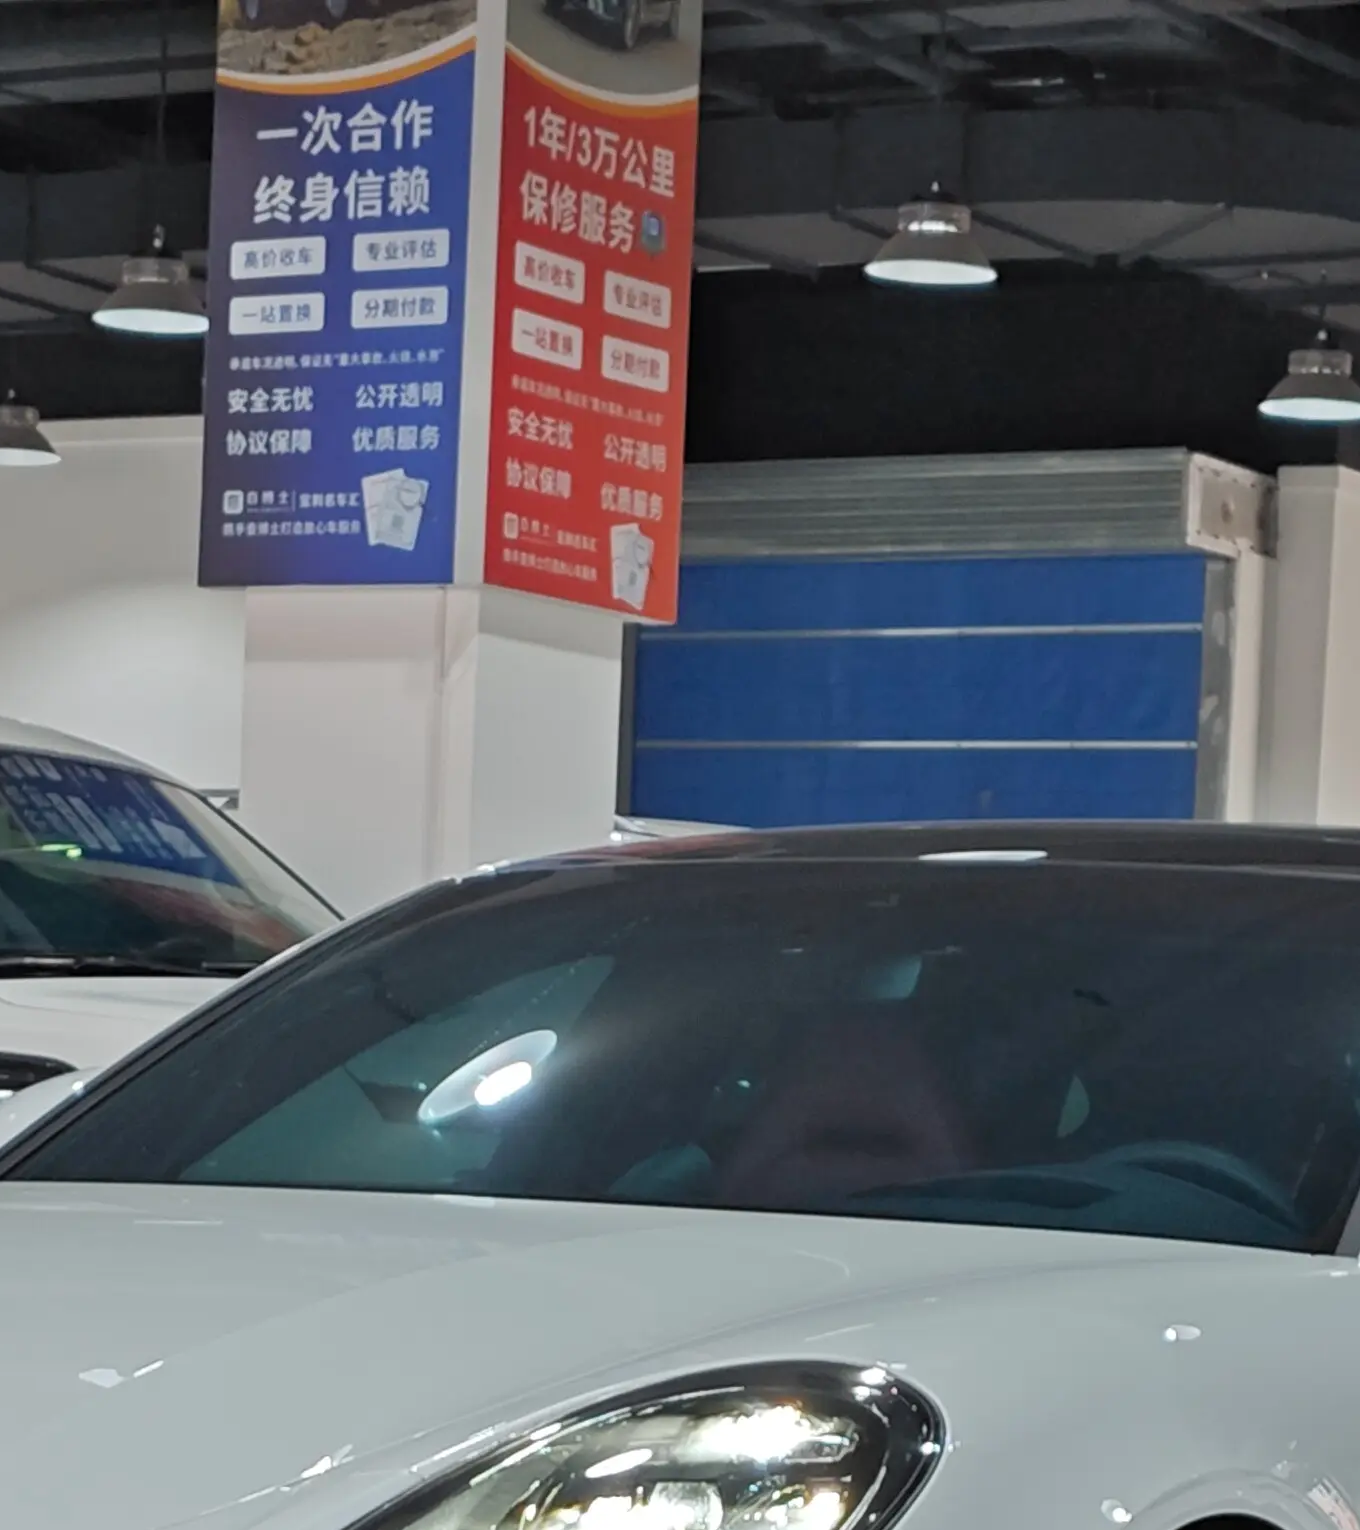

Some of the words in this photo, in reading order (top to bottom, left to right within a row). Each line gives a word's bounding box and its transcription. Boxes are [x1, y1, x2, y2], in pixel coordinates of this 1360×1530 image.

[256, 99, 434, 155] 一次合作
[524, 105, 675, 198] 1年/3万公里
[253, 165, 431, 224] 终身信赖
[520, 170, 635, 254] 保修服务
[243, 246, 313, 269] 高价收车
[366, 239, 437, 261] 专业评估
[242, 304, 311, 323] 一站置换
[364, 297, 435, 318] 分期付款
[610, 348, 661, 381] 分期付款
[228, 385, 314, 414] 安全无忧
[355, 381, 443, 408] 公开透明
[226, 428, 312, 456] 协议保障
[352, 424, 441, 452] 优质服务
[507, 405, 574, 450] 安全无忧
[603, 433, 667, 472] 公开透明
[505, 456, 572, 499] 协议保障
[600, 482, 664, 521] 优质服务
